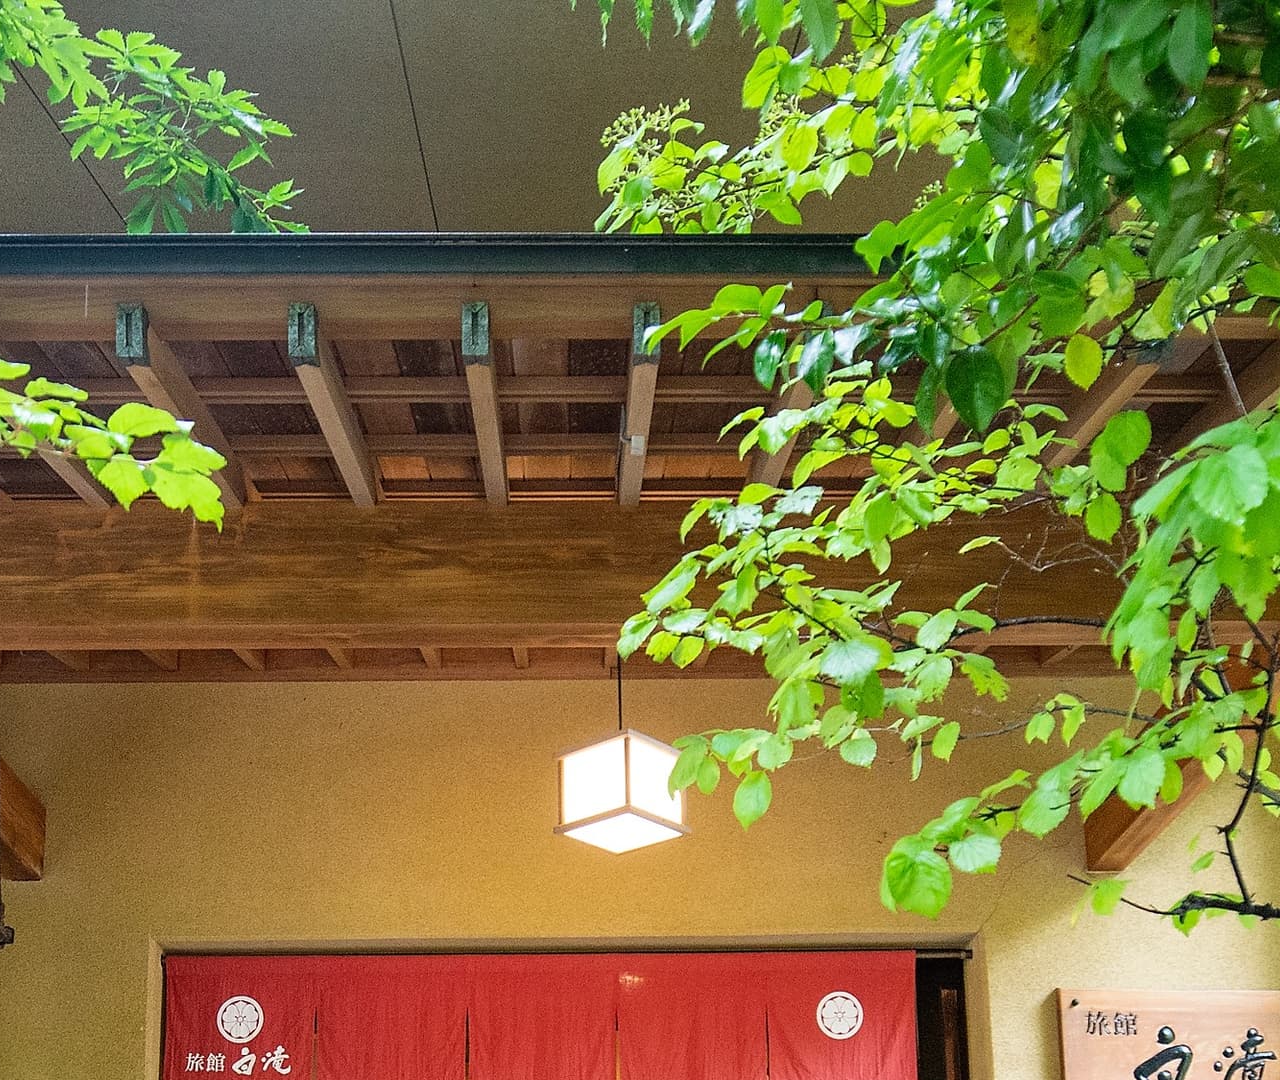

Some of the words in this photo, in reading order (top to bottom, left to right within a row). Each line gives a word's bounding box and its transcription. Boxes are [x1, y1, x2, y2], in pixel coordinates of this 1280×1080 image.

[1085, 1011, 1138, 1036] 旅館
[185, 1052, 226, 1072] 旅館
[232, 1046, 291, 1075] 白滝
